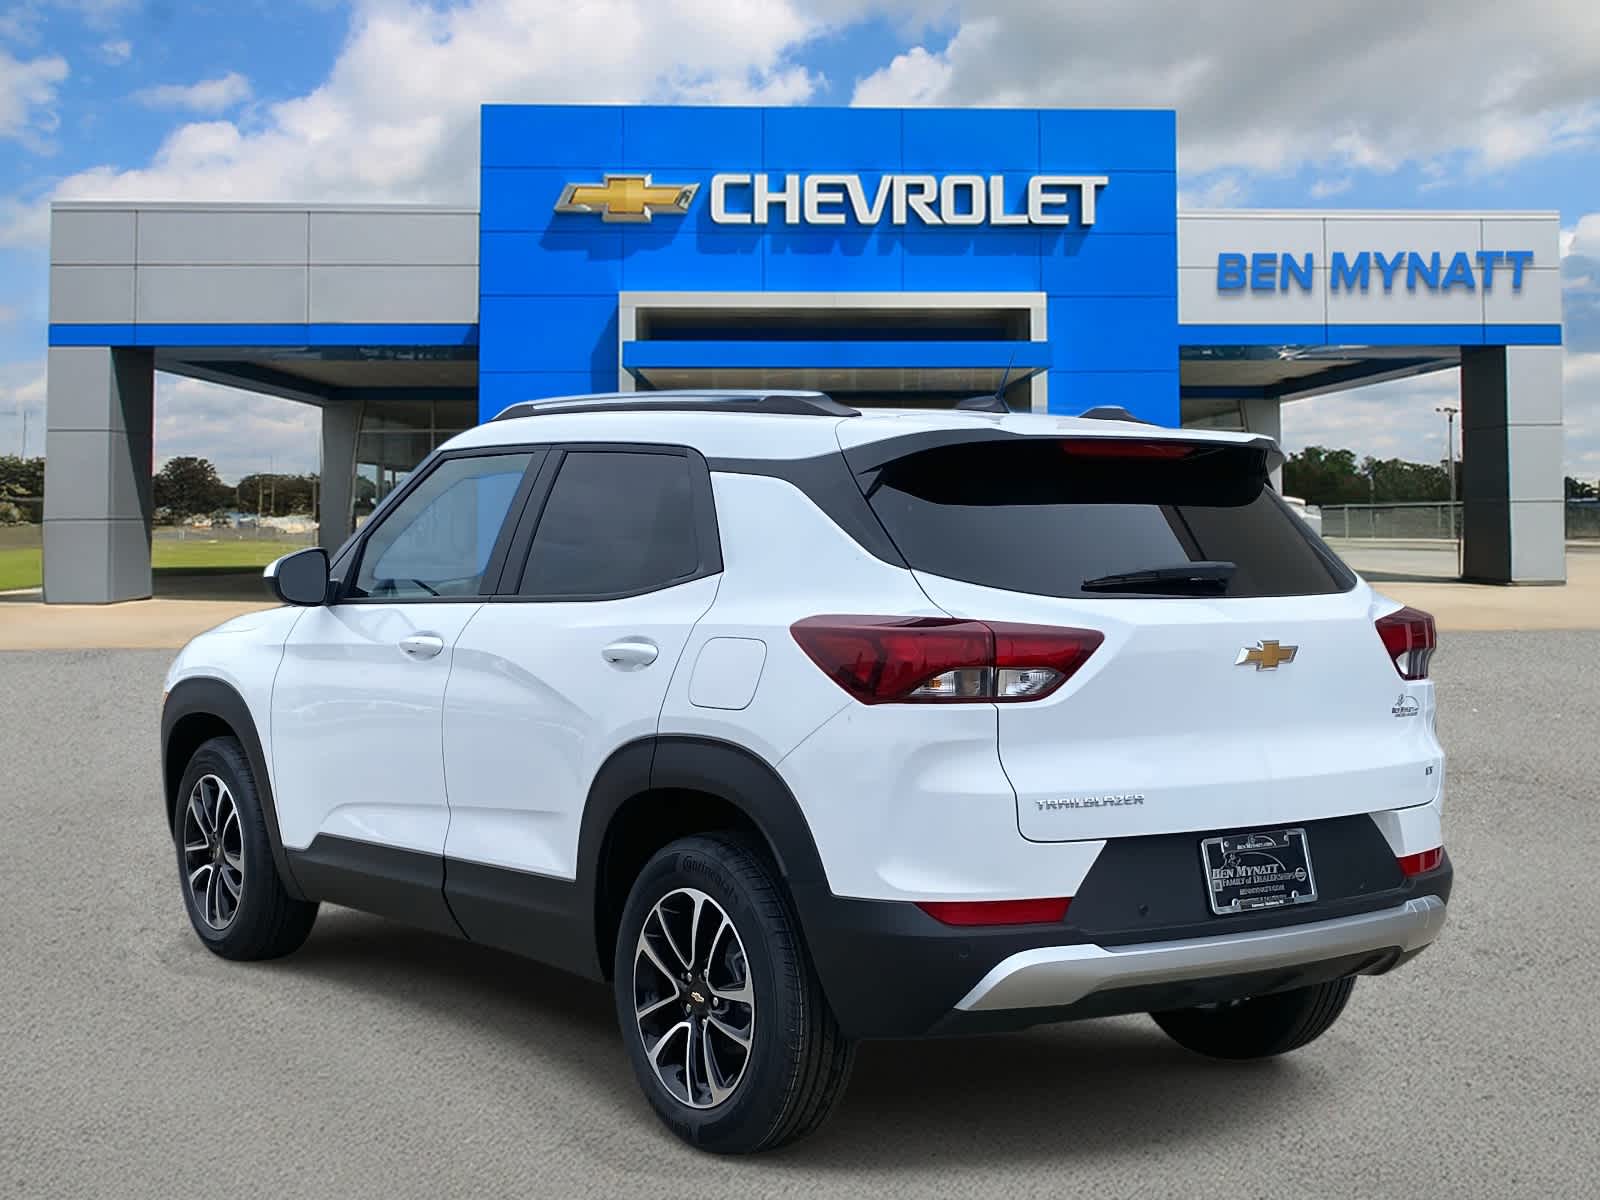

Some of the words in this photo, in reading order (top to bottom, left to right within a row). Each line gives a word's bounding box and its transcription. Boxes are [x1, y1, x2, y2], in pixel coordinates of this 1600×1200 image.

[711, 173, 1109, 225] CHEVROLET
[1217, 252, 1313, 290] BEN
[1330, 250, 1534, 291] MYNATT
[1035, 794, 1145, 810] TRAILBLAZER
[1212, 868, 1234, 879] BEN
[1236, 864, 1279, 878] MYNATT
[1222, 878, 1245, 887] FAMILY
